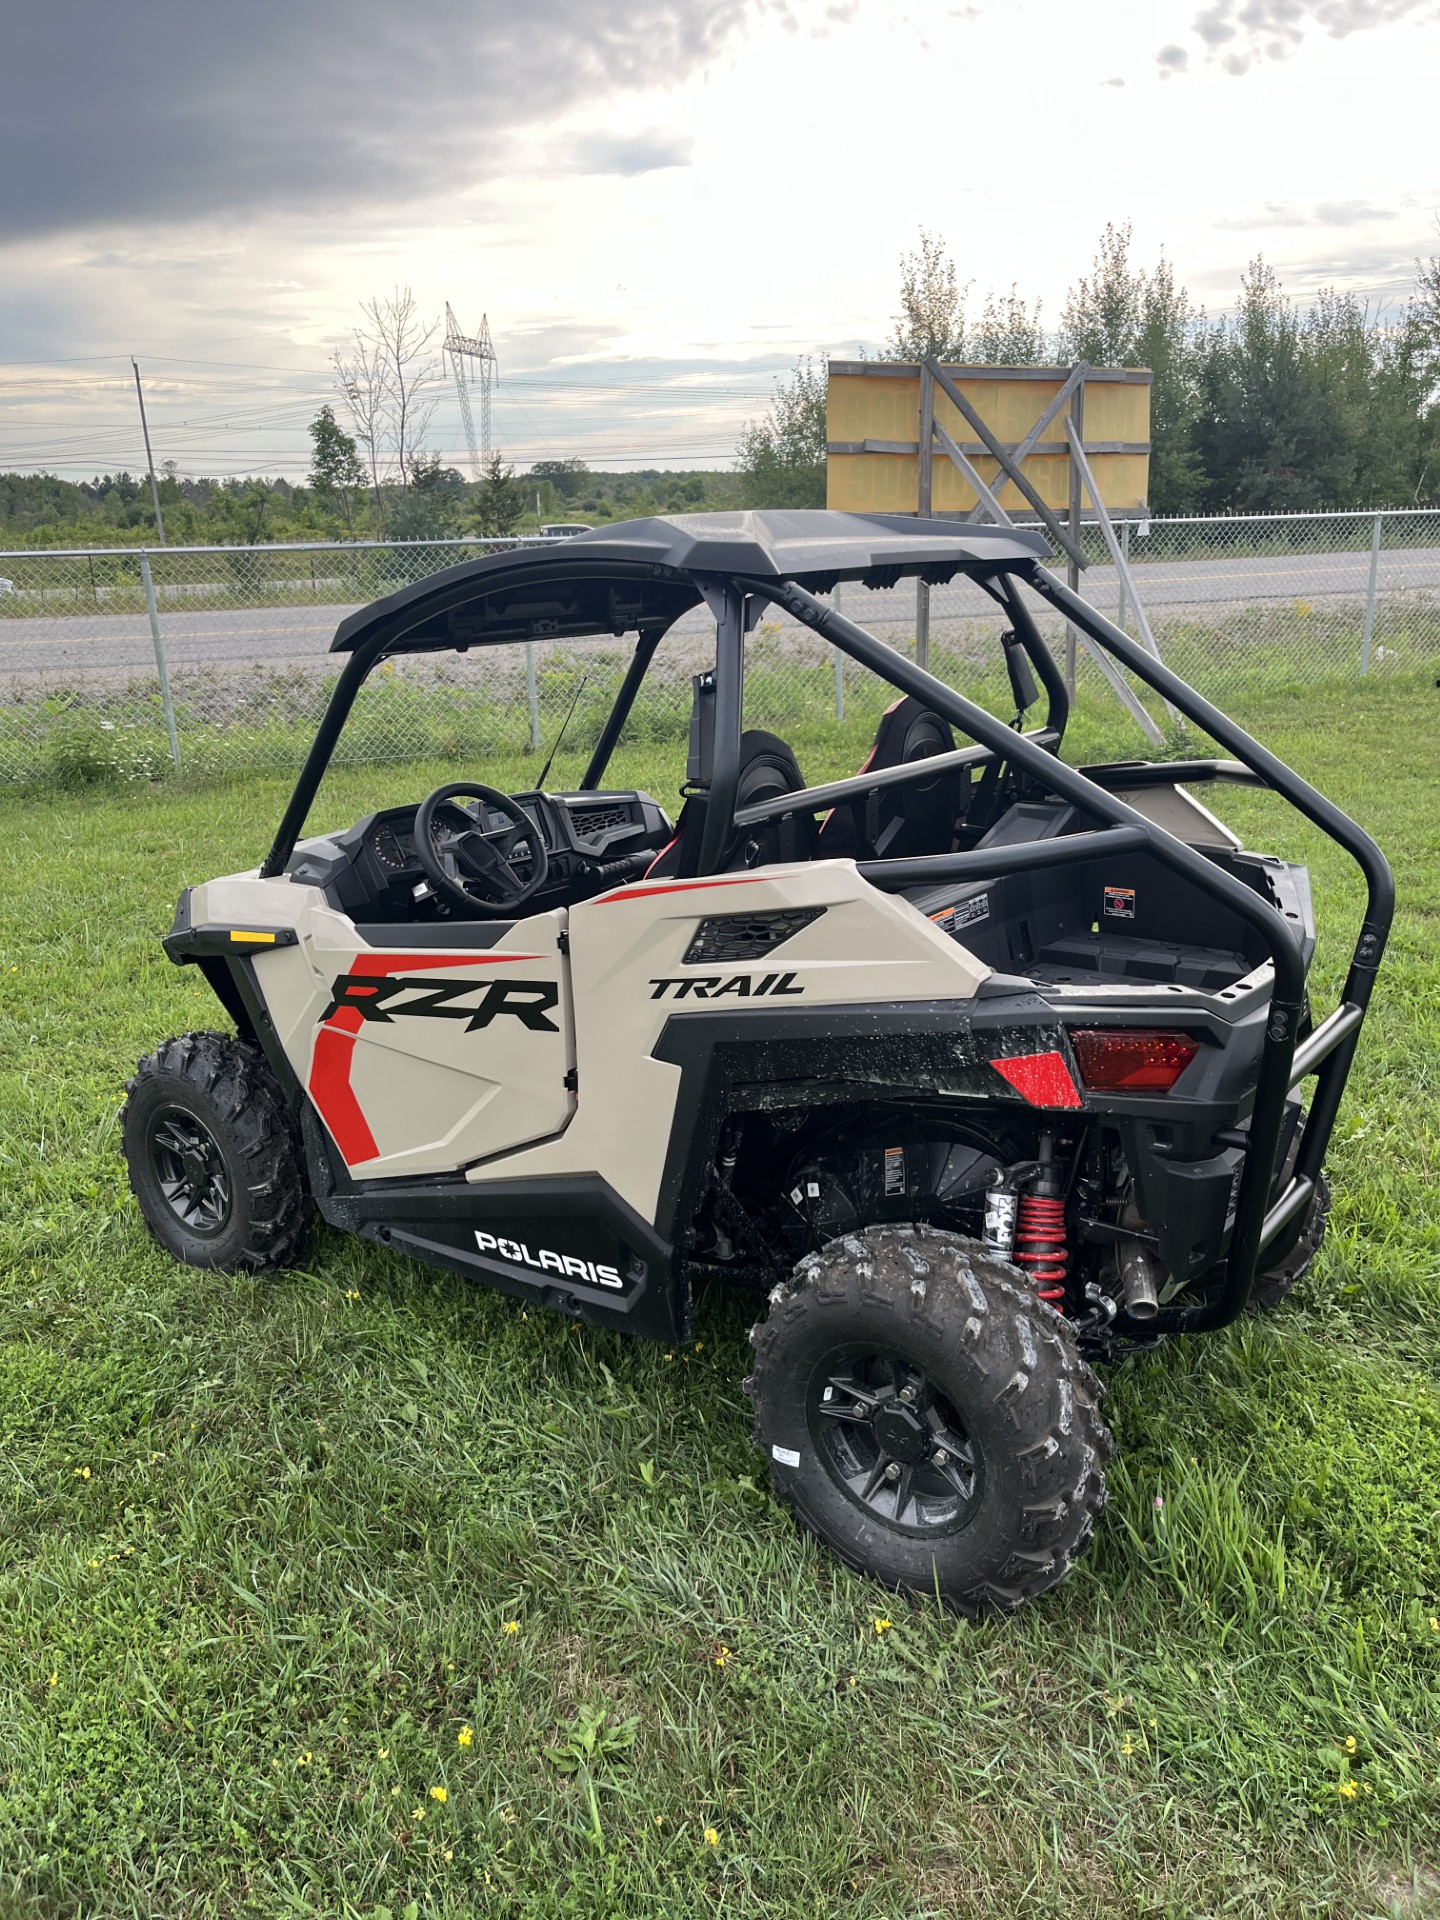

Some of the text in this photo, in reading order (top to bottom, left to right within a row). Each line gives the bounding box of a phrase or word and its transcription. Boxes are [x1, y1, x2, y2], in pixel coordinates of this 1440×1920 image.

[317, 974, 560, 1033] RZR
[648, 972, 805, 1000] TRAIL
[474, 1230, 623, 1288] POLARIS
